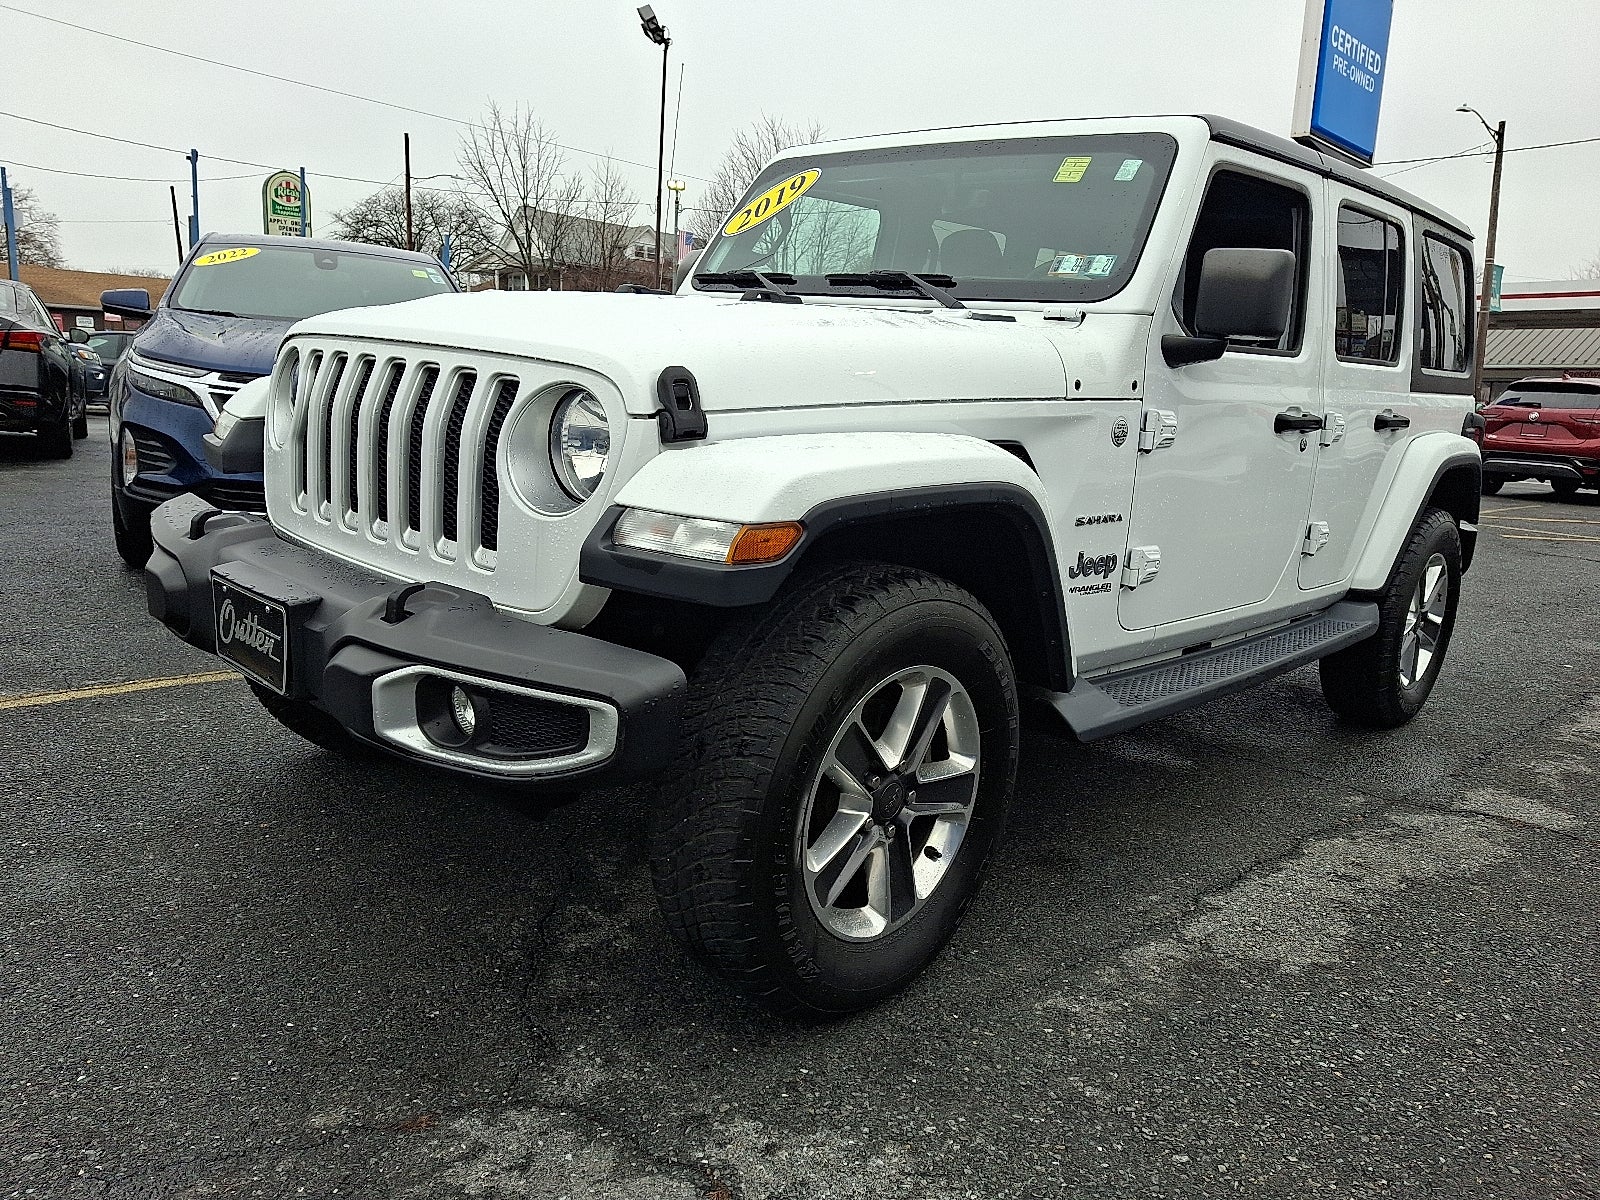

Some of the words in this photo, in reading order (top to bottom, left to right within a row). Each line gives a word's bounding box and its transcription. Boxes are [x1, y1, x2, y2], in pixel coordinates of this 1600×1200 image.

[1331, 25, 1381, 75] CERTIFIED
[1333, 54, 1375, 93] PRE-OWNED
[737, 175, 806, 231] 2019
[290, 220, 311, 228] ONLNE
[207, 248, 248, 264] 2022
[1562, 370, 1600, 379] Speedw
[1074, 514, 1123, 526] SAHARA
[1068, 551, 1118, 579] Jeep
[1068, 583, 1112, 593] WRANGLER
